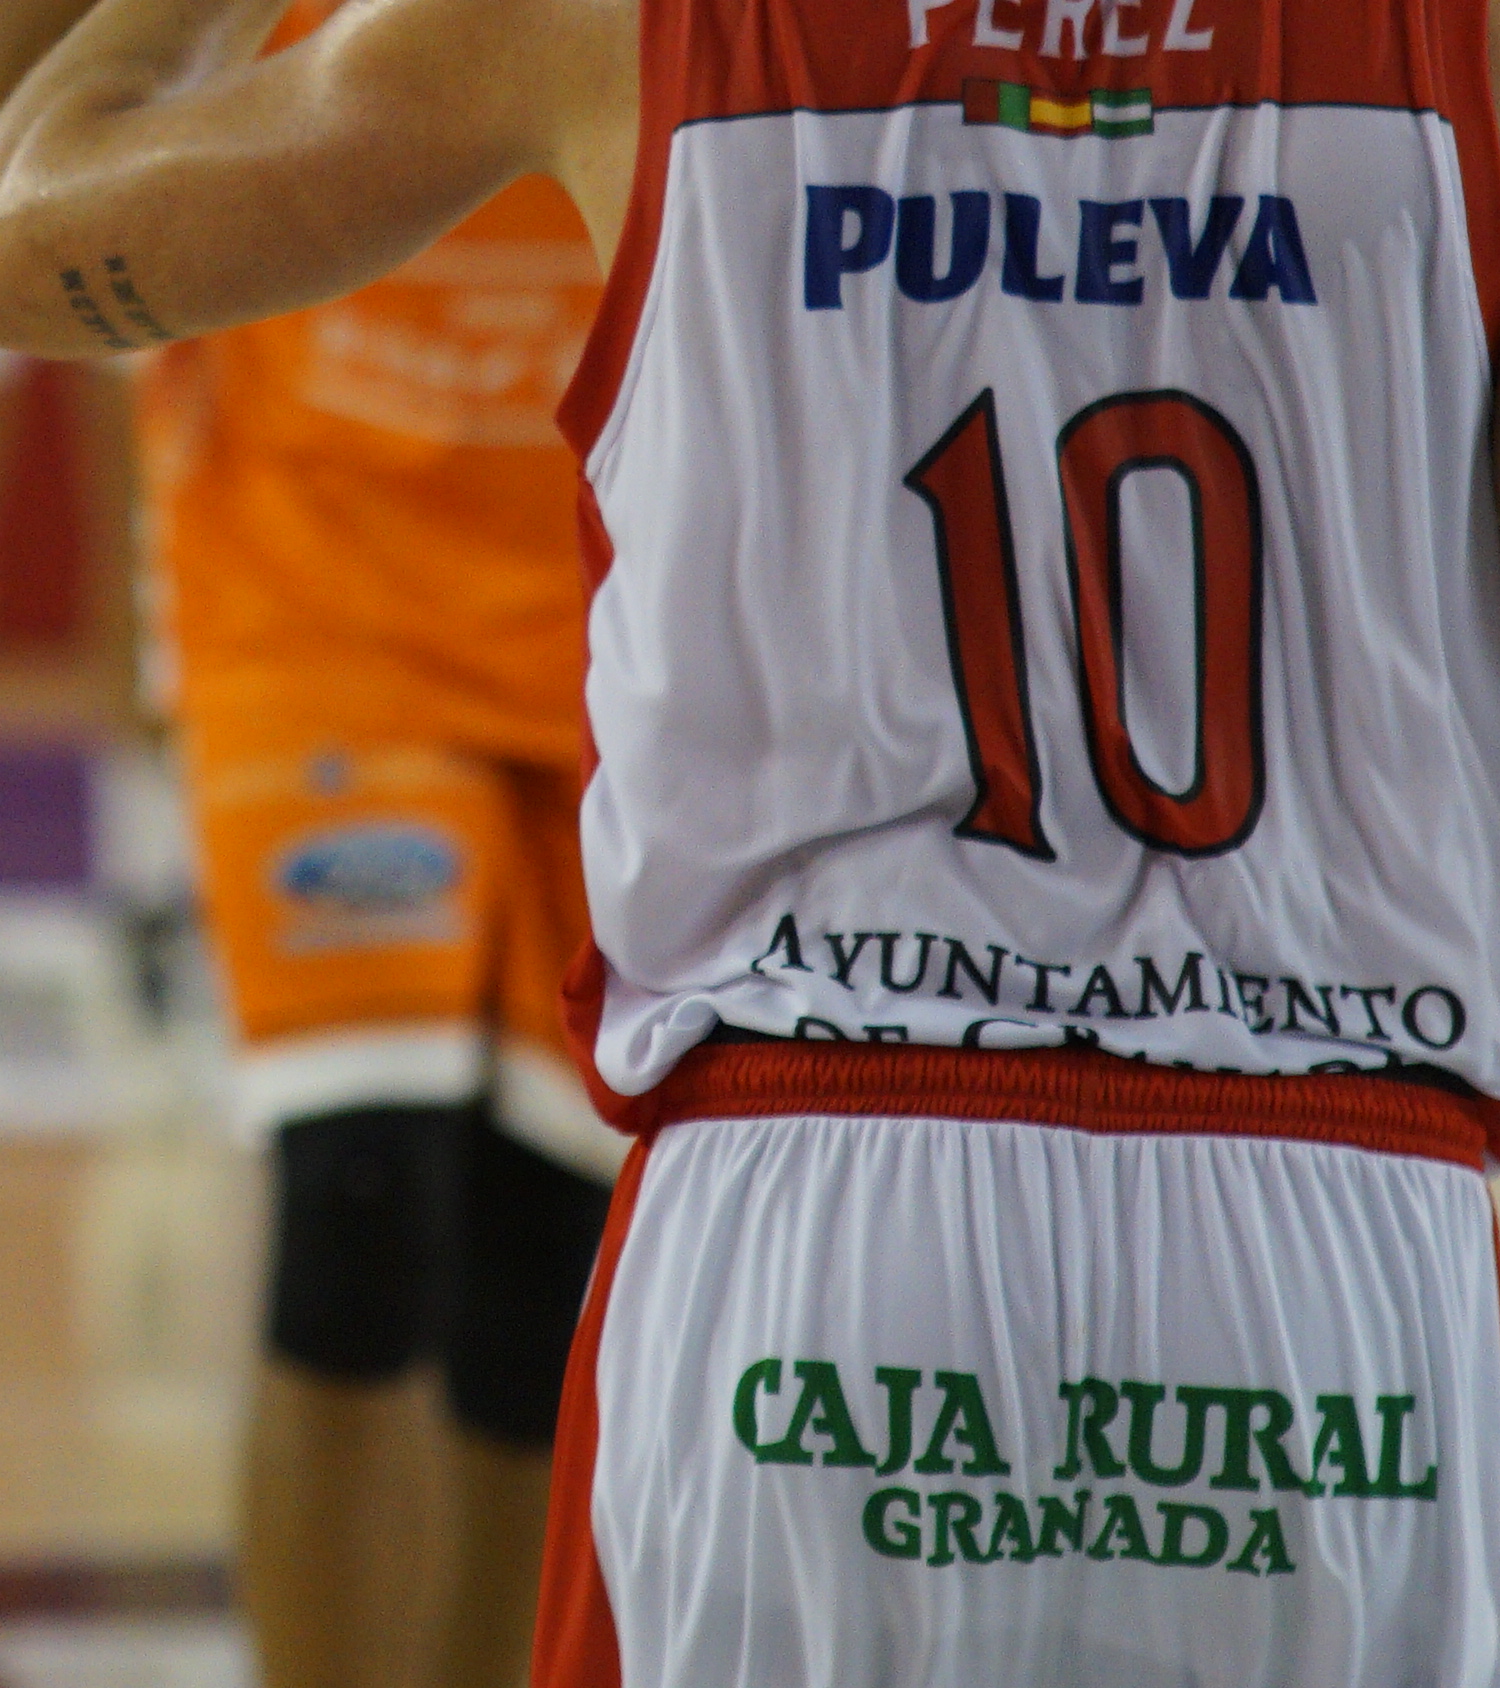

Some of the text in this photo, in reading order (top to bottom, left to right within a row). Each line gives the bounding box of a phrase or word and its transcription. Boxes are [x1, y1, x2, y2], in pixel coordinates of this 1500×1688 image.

[804, 184, 1318, 310] PULEVA
[903, 387, 1267, 861] 10
[751, 912, 1467, 1052] AYUNTAMIENTO
[732, 1358, 1438, 1500] CAJA RURAL
[861, 1486, 1296, 1575] GRANADA
